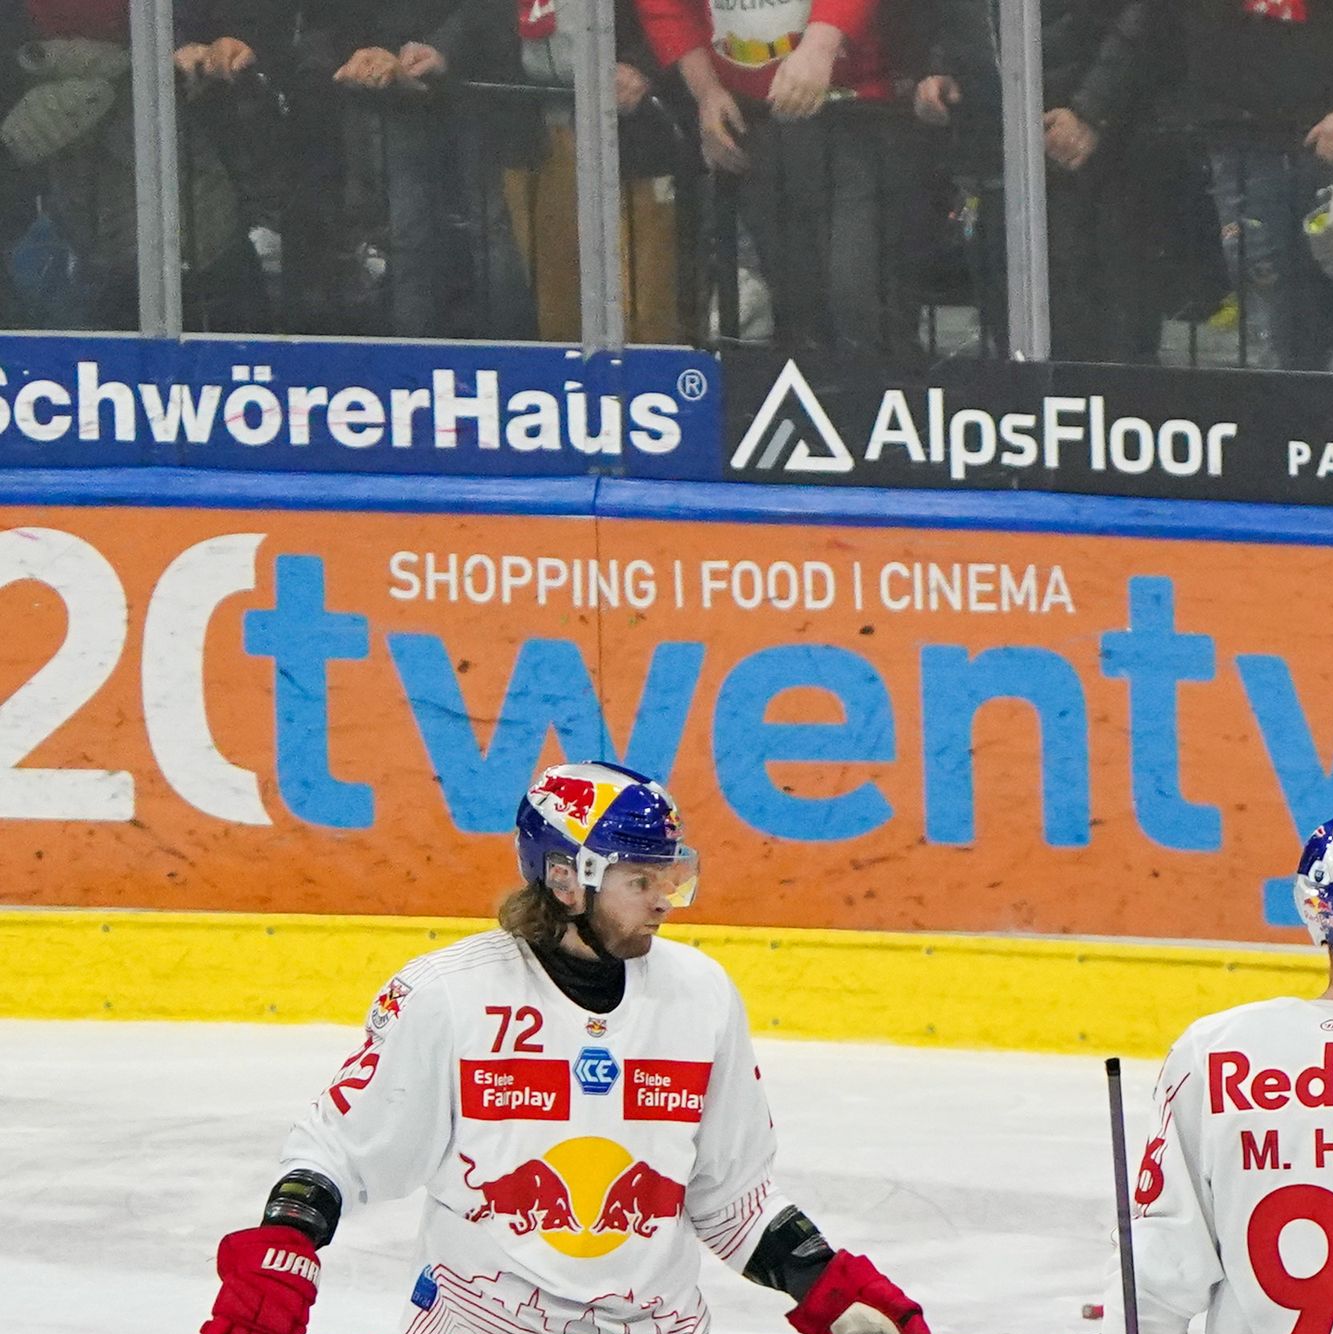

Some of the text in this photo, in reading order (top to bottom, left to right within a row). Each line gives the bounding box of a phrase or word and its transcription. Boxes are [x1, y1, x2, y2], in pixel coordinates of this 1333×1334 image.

[864, 387, 1237, 480] AlpsFloor
[389, 551, 1076, 614] SHOPPING FOOD CINEMA
[485, 1005, 545, 1053] 72
[574, 1060, 620, 1084] ICE
[645, 1070, 671, 1088] lebe
[482, 1086, 557, 1111] Fairplay
[1240, 1130, 1292, 1171] M.
